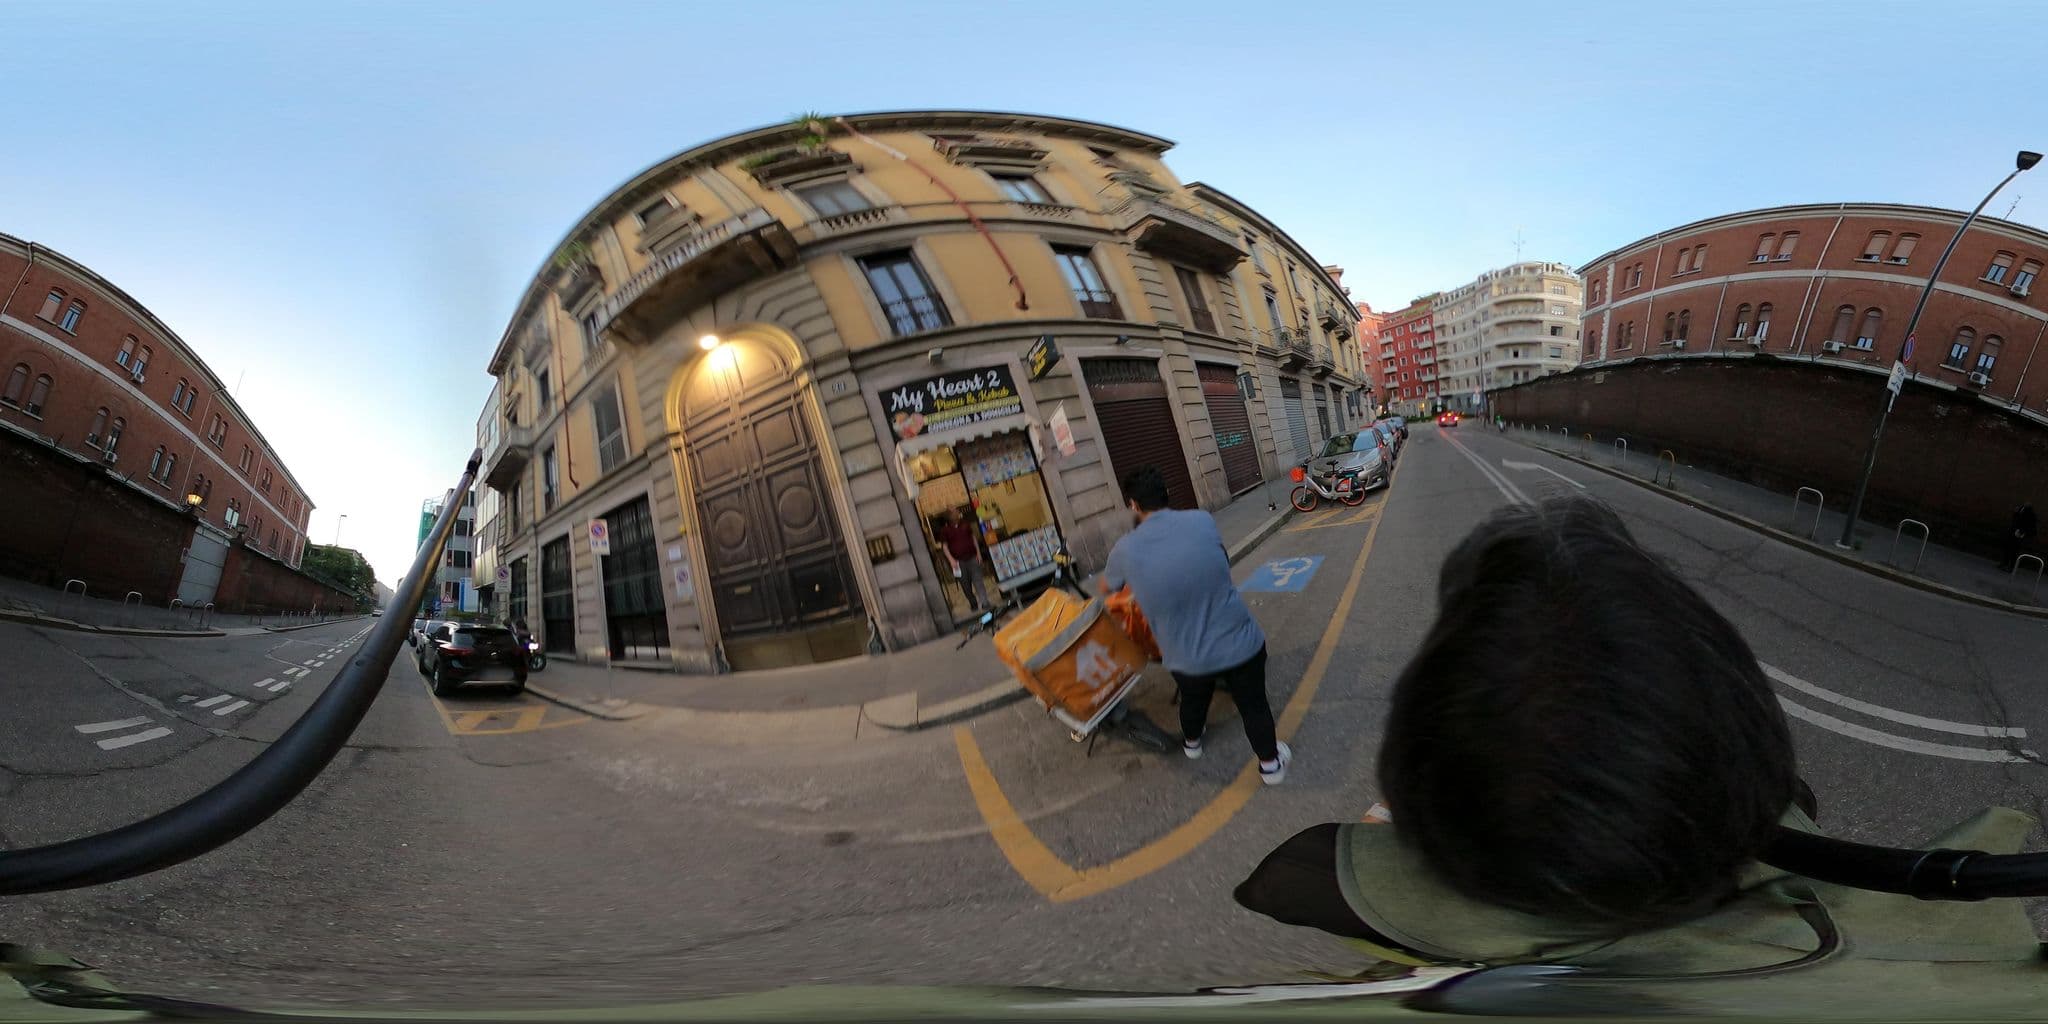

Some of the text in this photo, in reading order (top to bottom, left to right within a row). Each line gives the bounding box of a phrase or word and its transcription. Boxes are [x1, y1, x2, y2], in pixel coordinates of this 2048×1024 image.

[891, 386, 924, 412] My
[927, 377, 984, 400] Heart
[987, 370, 1000, 388] 2
